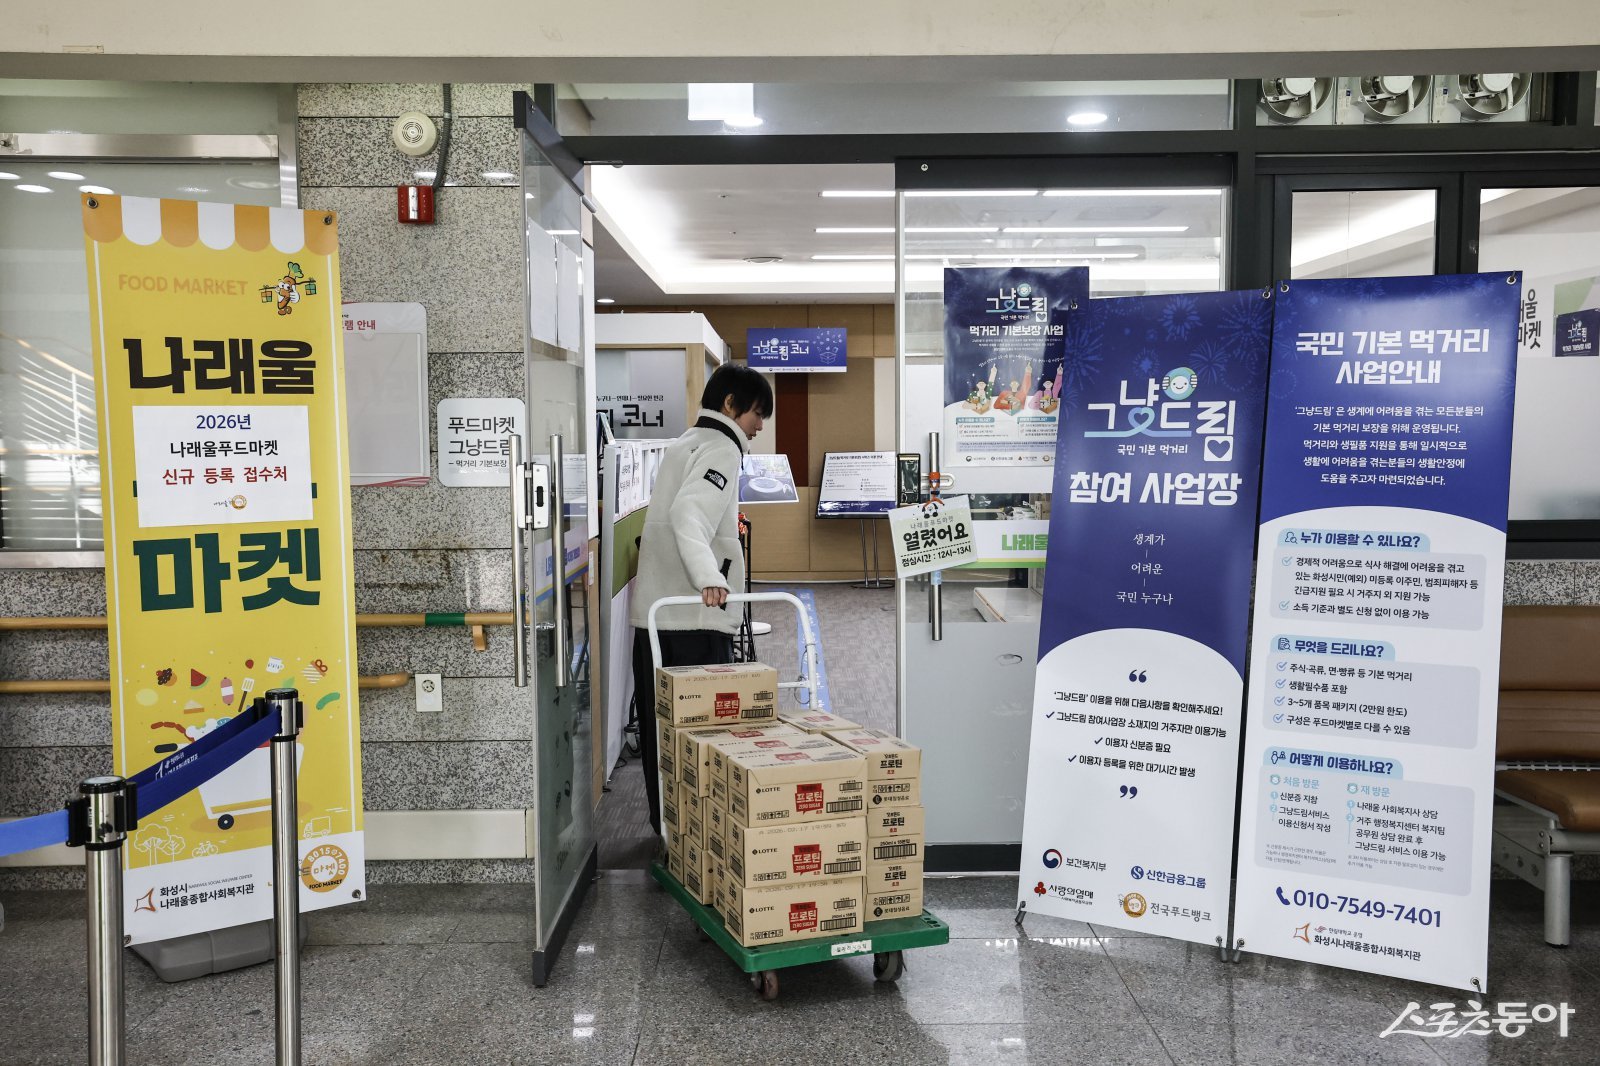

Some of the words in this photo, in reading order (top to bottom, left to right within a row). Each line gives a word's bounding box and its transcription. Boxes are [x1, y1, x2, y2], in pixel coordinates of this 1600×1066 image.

[118, 274, 168, 292] FOOD
[173, 278, 249, 296] MARKET
[986, 287, 1047, 322] 그냥드림
[357, 320, 376, 330] 안내
[970, 326, 999, 336] 먹거리
[1002, 325, 1041, 336] 기본보장
[1043, 325, 1063, 335] 사업
[791, 344, 809, 354] 코너
[1296, 332, 1344, 355] 국민
[1352, 330, 1402, 354] 기본
[1410, 329, 1489, 354] 먹거리
[123, 337, 316, 395] 나래울
[1336, 360, 1441, 384] 사업안내
[621, 404, 663, 427] 코너
[1336, 407, 1344, 416] 은
[1347, 407, 1374, 416] 생계에
[1376, 407, 1412, 416] 어려움을
[1415, 407, 1433, 416] 겪는
[1436, 407, 1483, 416] 모든분들의
[196, 414, 252, 430] 2026년
[448, 417, 515, 434] 푸드마켓
[1084, 378, 1236, 461] 그냥드림
[1313, 424, 1330, 432] 기본
[1333, 424, 1359, 433] 먹거리
[1362, 424, 1388, 433] 보장을
[1391, 424, 1409, 433] 위해
[1412, 424, 1460, 434] 운영됩니다.
[170, 439, 278, 458] 나래울푸드마켓
[1118, 445, 1135, 455] 국민
[1139, 445, 1156, 454] 기본
[1160, 445, 1188, 454] 먹거리
[1304, 440, 1338, 450] 먹거리와
[1340, 440, 1367, 450] 생필품
[1370, 441, 1397, 450] 지원을
[1399, 441, 1417, 450] 통해
[1420, 441, 1467, 451] 일시적으로
[1304, 457, 1329, 466] 생활에
[1332, 458, 1366, 467] 어려움을
[1370, 458, 1415, 468] 겪는분들의
[1418, 459, 1465, 468] 생활안정에
[162, 468, 194, 486] 신규
[204, 468, 235, 484] 등록
[244, 466, 288, 482] 접수처
[1321, 474, 1347, 483] 도움을
[1350, 475, 1376, 484] 주고자
[1379, 476, 1445, 486] 마련되었습니다.
[1070, 472, 1131, 503] 참여
[1140, 472, 1242, 506] 사업장
[903, 523, 968, 551] 열렸어요
[1134, 534, 1165, 545] 생계가
[1300, 532, 1322, 544] 누가
[1325, 533, 1358, 545] 이용할
[1362, 535, 1373, 546] 수
[1378, 535, 1420, 548] 있나요?
[901, 554, 931, 567] 점심시간
[938, 546, 971, 559] 12시~13시
[133, 528, 321, 613] 마켓
[1132, 563, 1163, 574] 어려운
[1296, 557, 1320, 567] 경제적
[1322, 558, 1362, 569] 어려움으로
[1364, 561, 1381, 570] 식사
[1383, 561, 1408, 571] 해결에
[1411, 562, 1444, 572] 어려움을
[1448, 564, 1464, 573] 겪고
[1296, 572, 1310, 581] 있는
[1313, 572, 1367, 583] 화성시민(예외)
[1370, 575, 1394, 585] 미등록
[1425, 578, 1467, 588] 범죄피해자
[1470, 580, 1478, 589] 등
[1117, 592, 1137, 603] 국민
[1141, 593, 1173, 605] 누구나
[1295, 640, 1327, 653] 무엇을
[1331, 643, 1384, 657] 드리나요?
[1358, 669, 1366, 678] 등
[1368, 669, 1384, 679] 기본
[1387, 671, 1412, 681] 먹거리
[1289, 681, 1329, 692] 생활필수품
[1090, 695, 1112, 705] 이용을
[1115, 698, 1130, 707] 위해
[1131, 699, 1170, 710] 다음사항을
[1172, 702, 1222, 715] 확인해주세요!
[1056, 712, 1086, 723] 그냥드림
[1088, 715, 1126, 727] 참여사업장
[1128, 719, 1158, 730] 소재지의
[1161, 722, 1192, 734] 거주자만
[1195, 726, 1226, 737] 이용가능
[1106, 738, 1128, 748] 이용자
[1130, 741, 1153, 751] 신분증
[1156, 742, 1171, 753] 필요
[880, 760, 902, 768] 프로틴
[1079, 755, 1101, 765] 이용자
[1104, 758, 1126, 769] 등록을
[1128, 761, 1143, 771] 위한
[1146, 763, 1177, 775] 대기시간
[1180, 767, 1195, 777] 발생
[1289, 752, 1323, 767] 어떻게
[1327, 756, 1393, 774] 이용하나요?
[1283, 776, 1300, 787] 처음
[1303, 778, 1319, 788] 방문
[796, 792, 823, 803] 프로틴
[1361, 786, 1370, 795] 재
[1372, 787, 1391, 797] 방문
[1279, 806, 1330, 819] 그냥드림서비스
[1357, 802, 1380, 812] 나래울
[882, 817, 904, 826] 프로틴
[1355, 841, 1386, 852] 그냥드림
[793, 853, 820, 864] 프로틴
[1066, 858, 1106, 871] 보건복지부
[885, 871, 906, 880] 프로틴
[1146, 870, 1206, 888] 신한금융그룹
[160, 883, 188, 896] 화성시
[160, 884, 254, 909] 나래울종합사회복지관
[1048, 885, 1094, 899] 사랑의열매
[1151, 903, 1211, 922] 전국푸드뱅크
[1293, 889, 1441, 927] 010-7549-7401
[790, 911, 817, 922] 프로틴
[1314, 935, 1421, 961] 화성시나래울종합사회복지관
